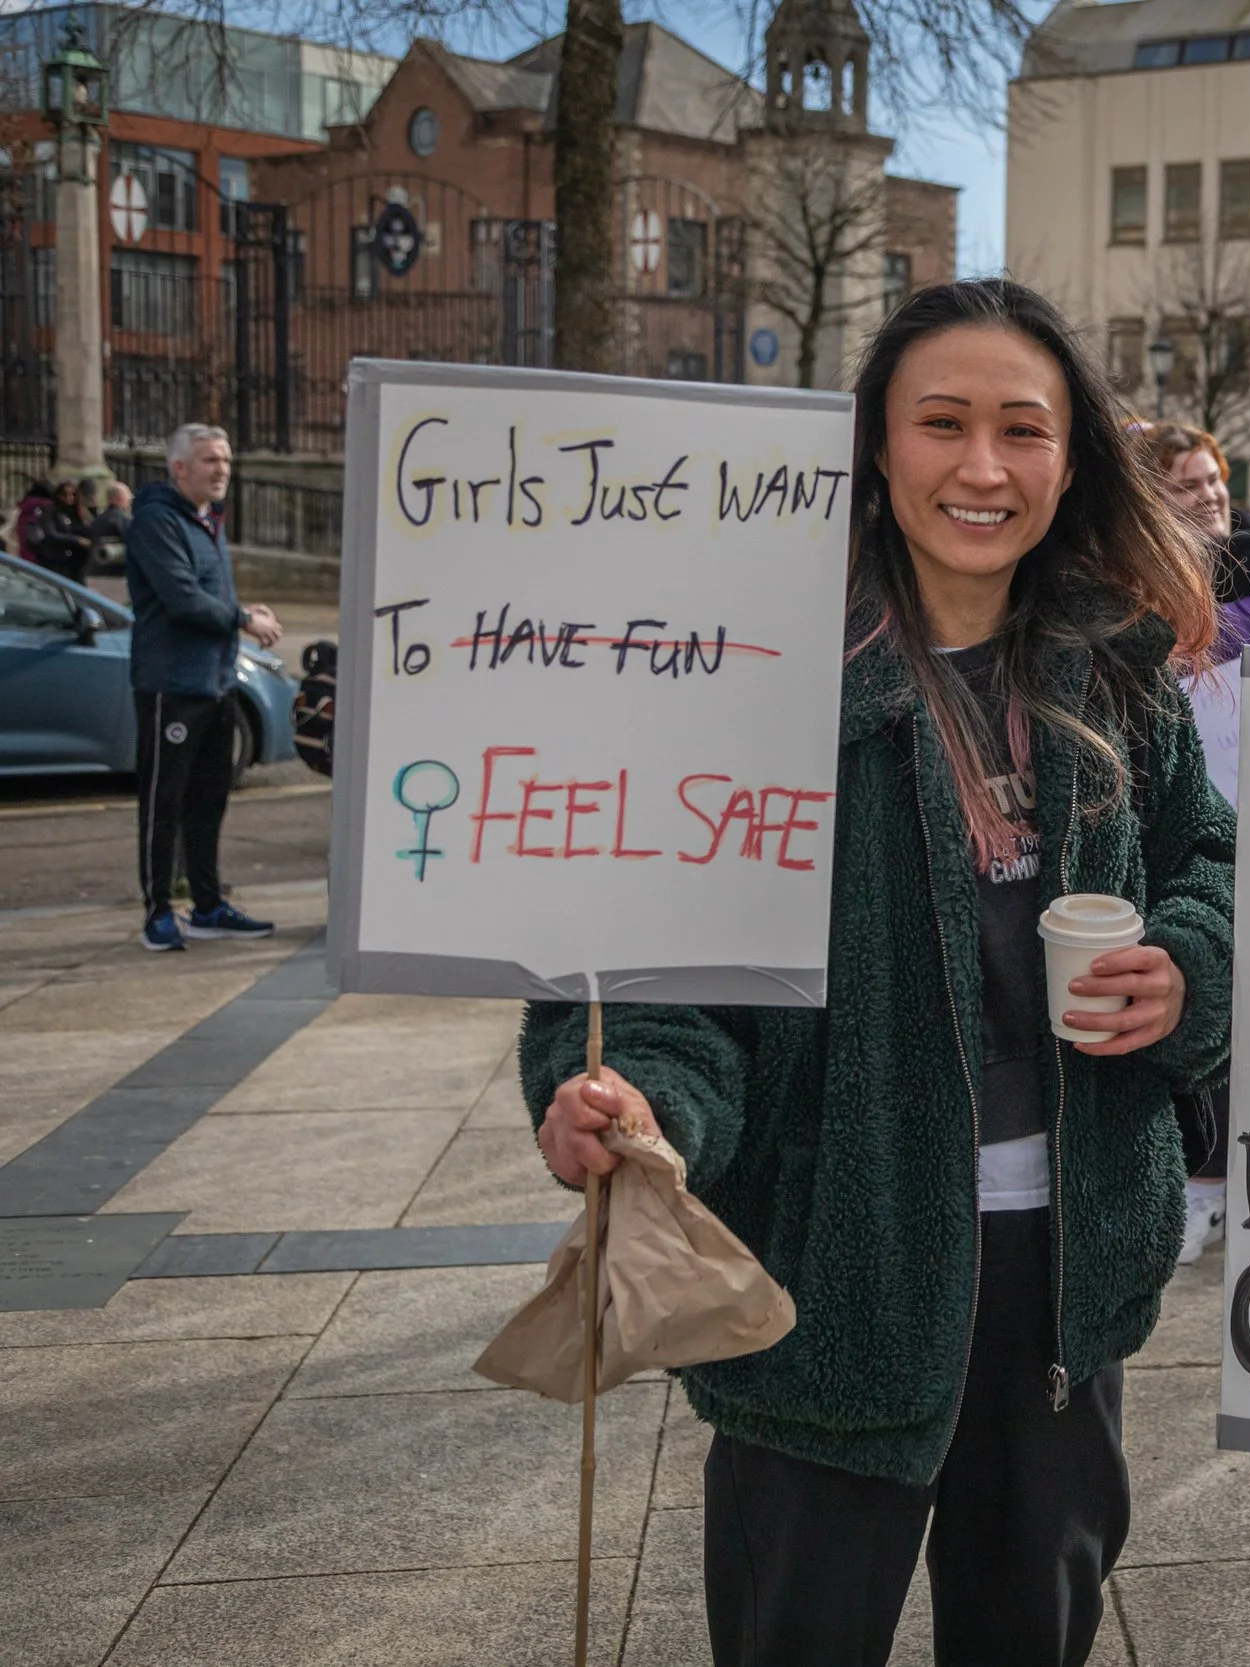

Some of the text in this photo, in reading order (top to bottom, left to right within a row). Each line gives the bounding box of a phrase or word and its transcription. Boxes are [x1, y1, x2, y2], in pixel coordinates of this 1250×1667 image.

[396, 417, 849, 527] Girls Just WANT
[373, 599, 431, 676] To
[469, 602, 596, 671] HAVE
[471, 746, 836, 871] FEEL SAFE
